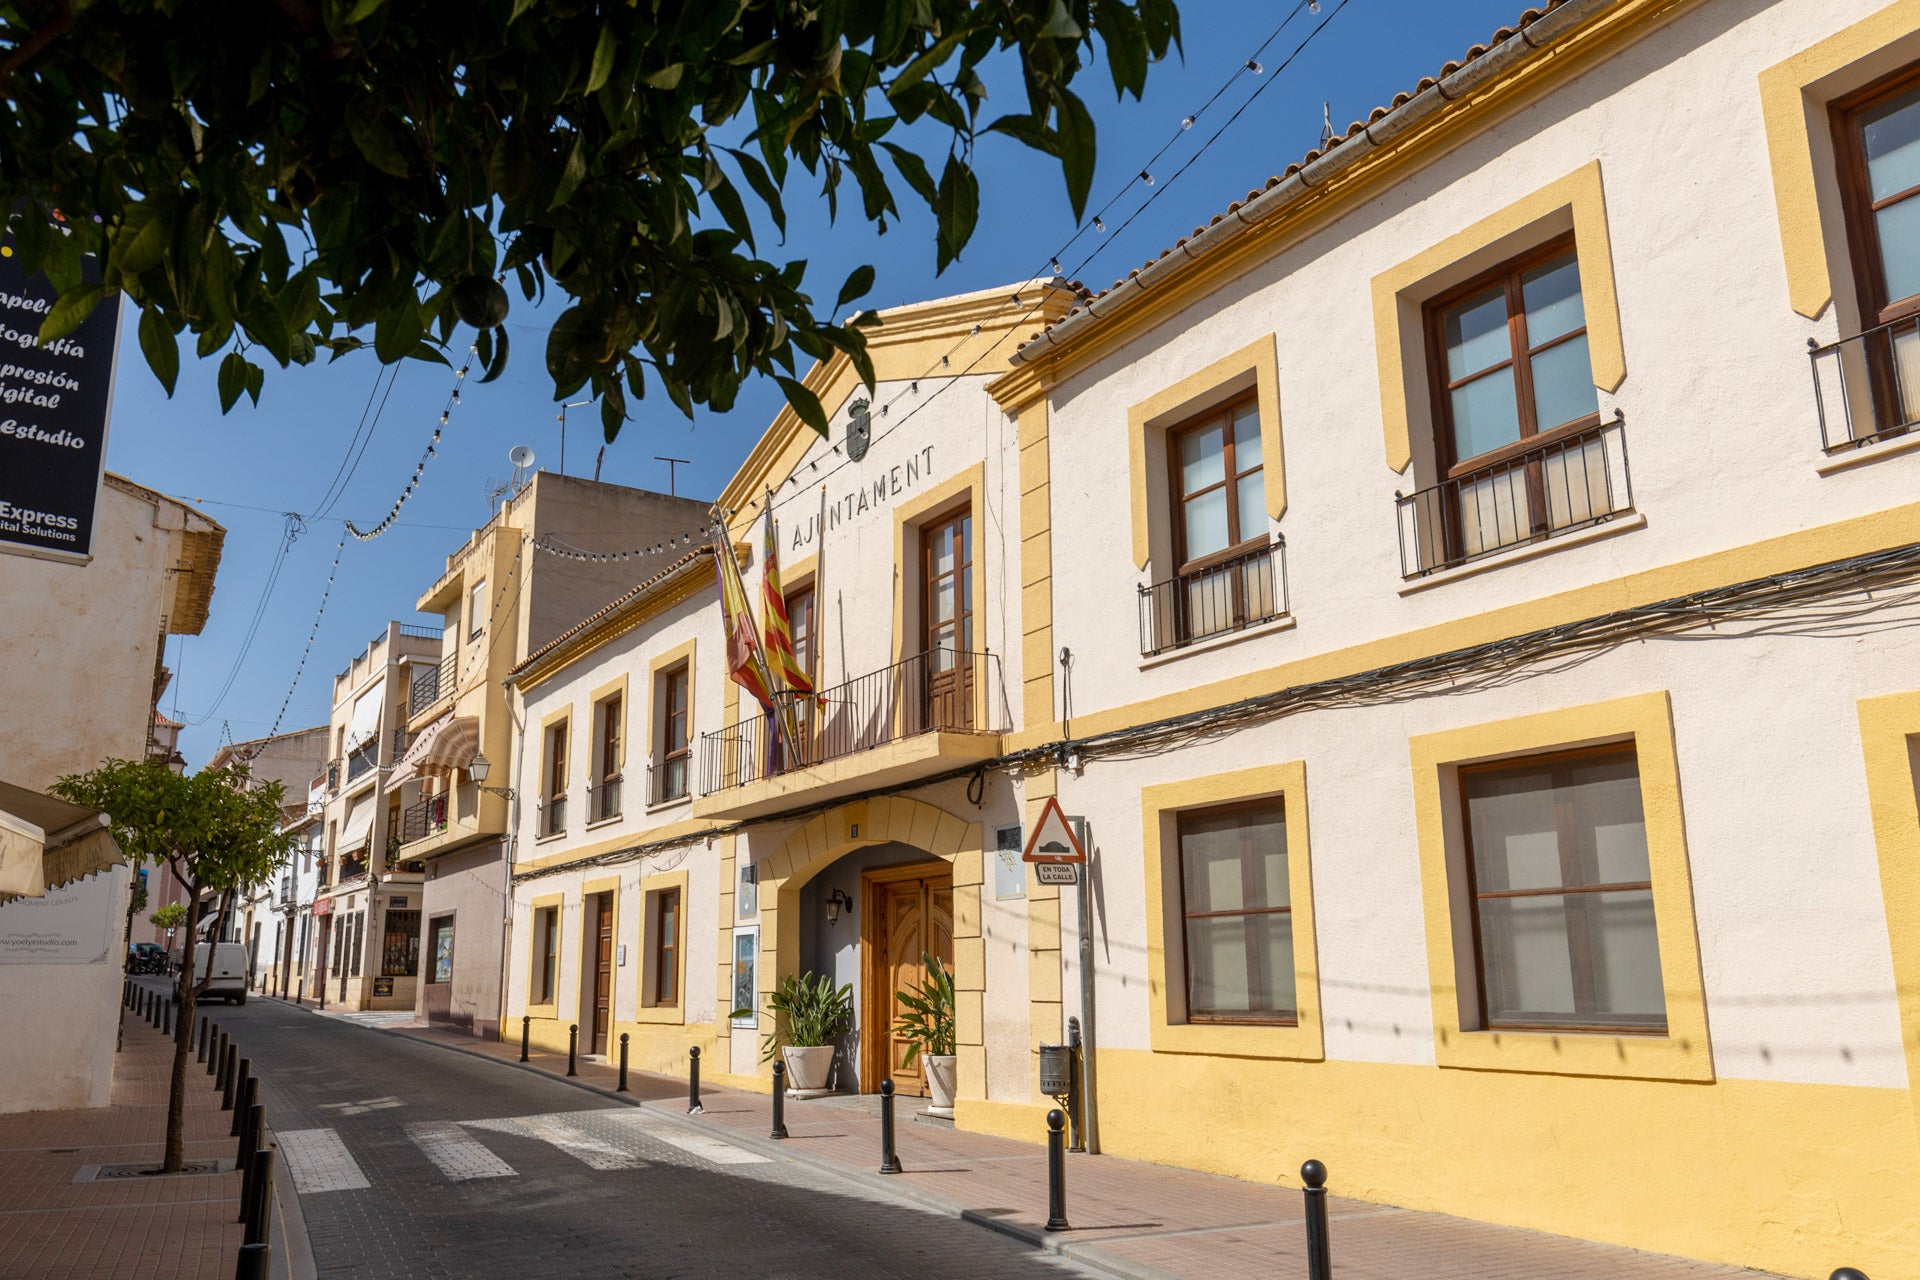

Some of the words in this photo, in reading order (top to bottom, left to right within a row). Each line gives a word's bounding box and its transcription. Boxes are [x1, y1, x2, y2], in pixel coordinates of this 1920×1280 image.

[0, 363, 79, 391] presión
[0, 500, 78, 530] Express
[22, 524, 76, 542] Solutions
